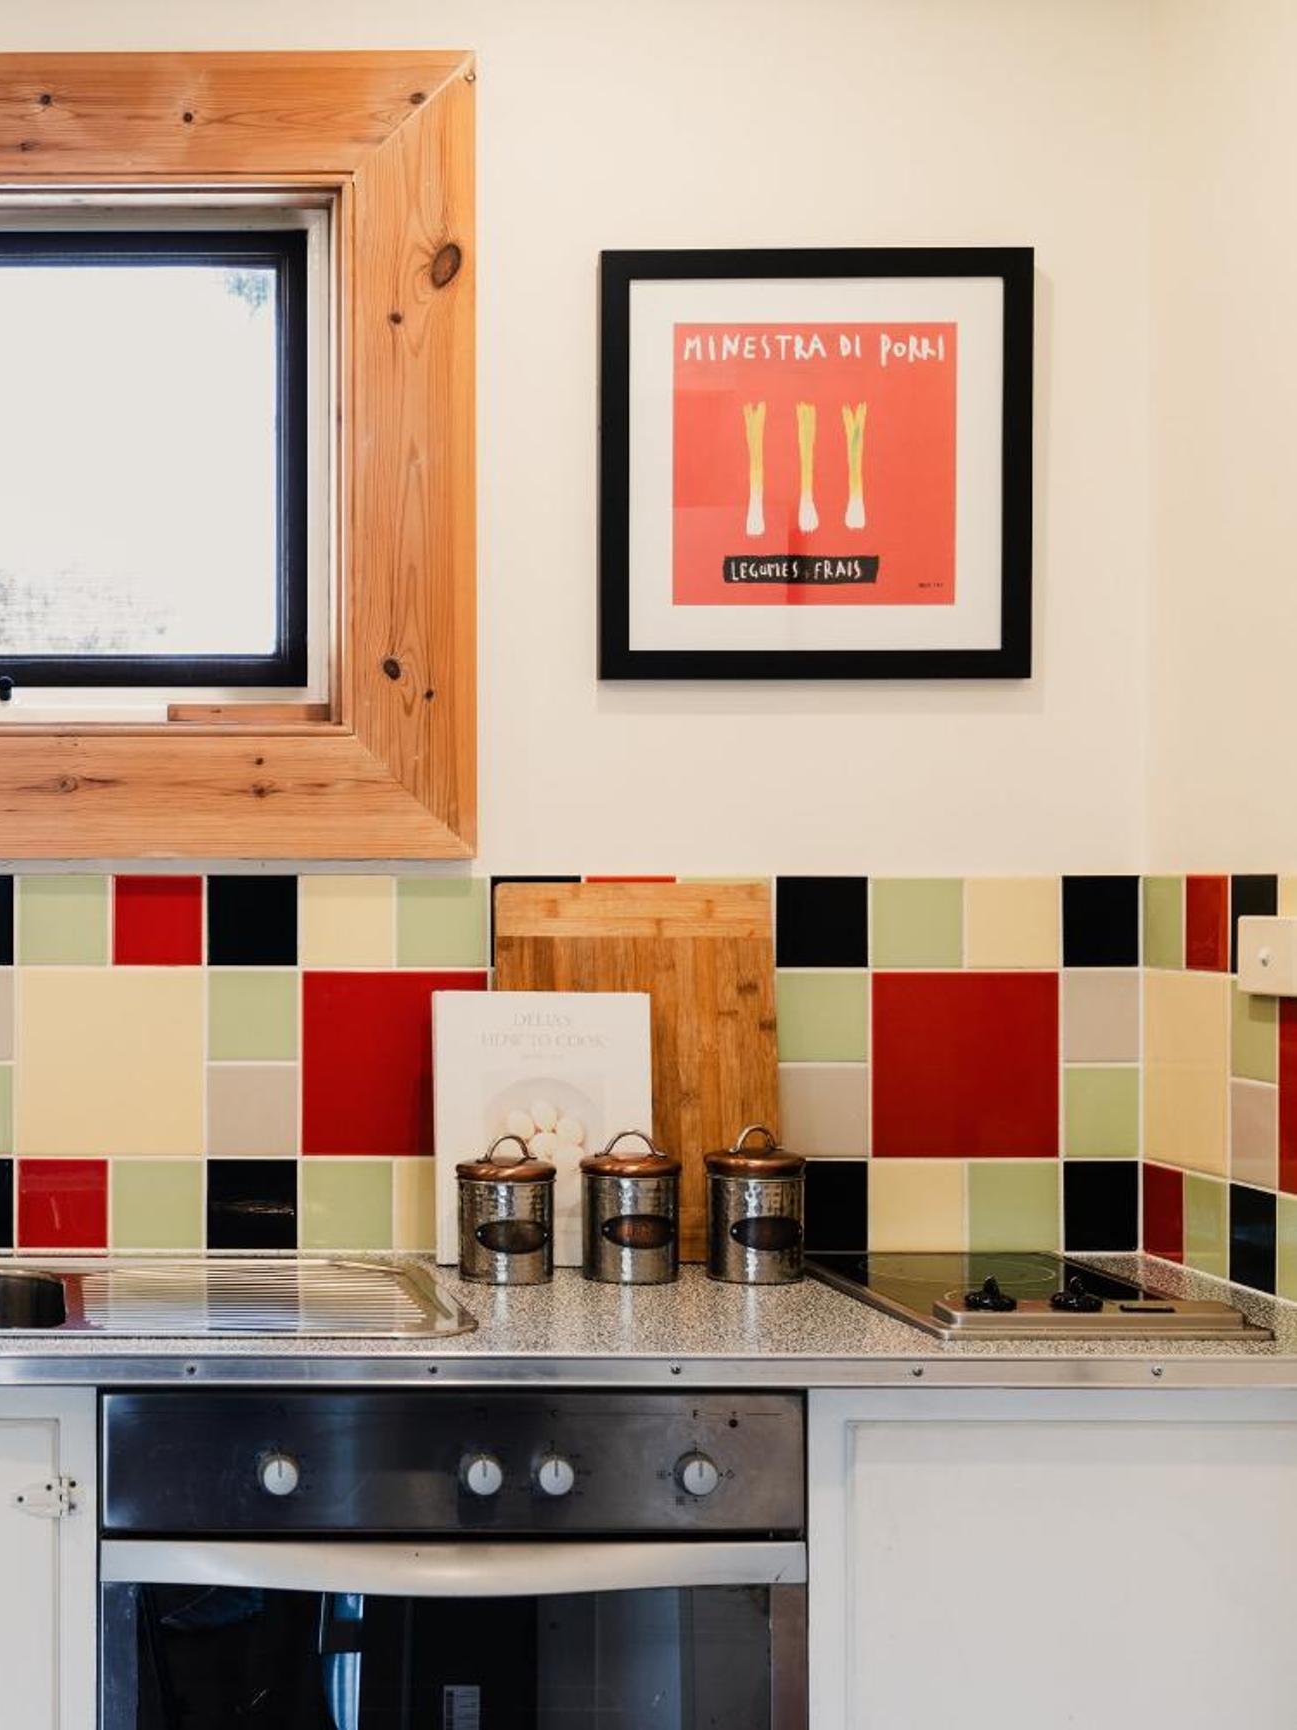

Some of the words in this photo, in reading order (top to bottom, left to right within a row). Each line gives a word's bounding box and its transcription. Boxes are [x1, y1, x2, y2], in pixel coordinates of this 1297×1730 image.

[683, 334, 827, 361] MINESTRA
[839, 335, 862, 358] DI
[880, 334, 945, 367] PORRI
[814, 560, 862, 579] FRAIS
